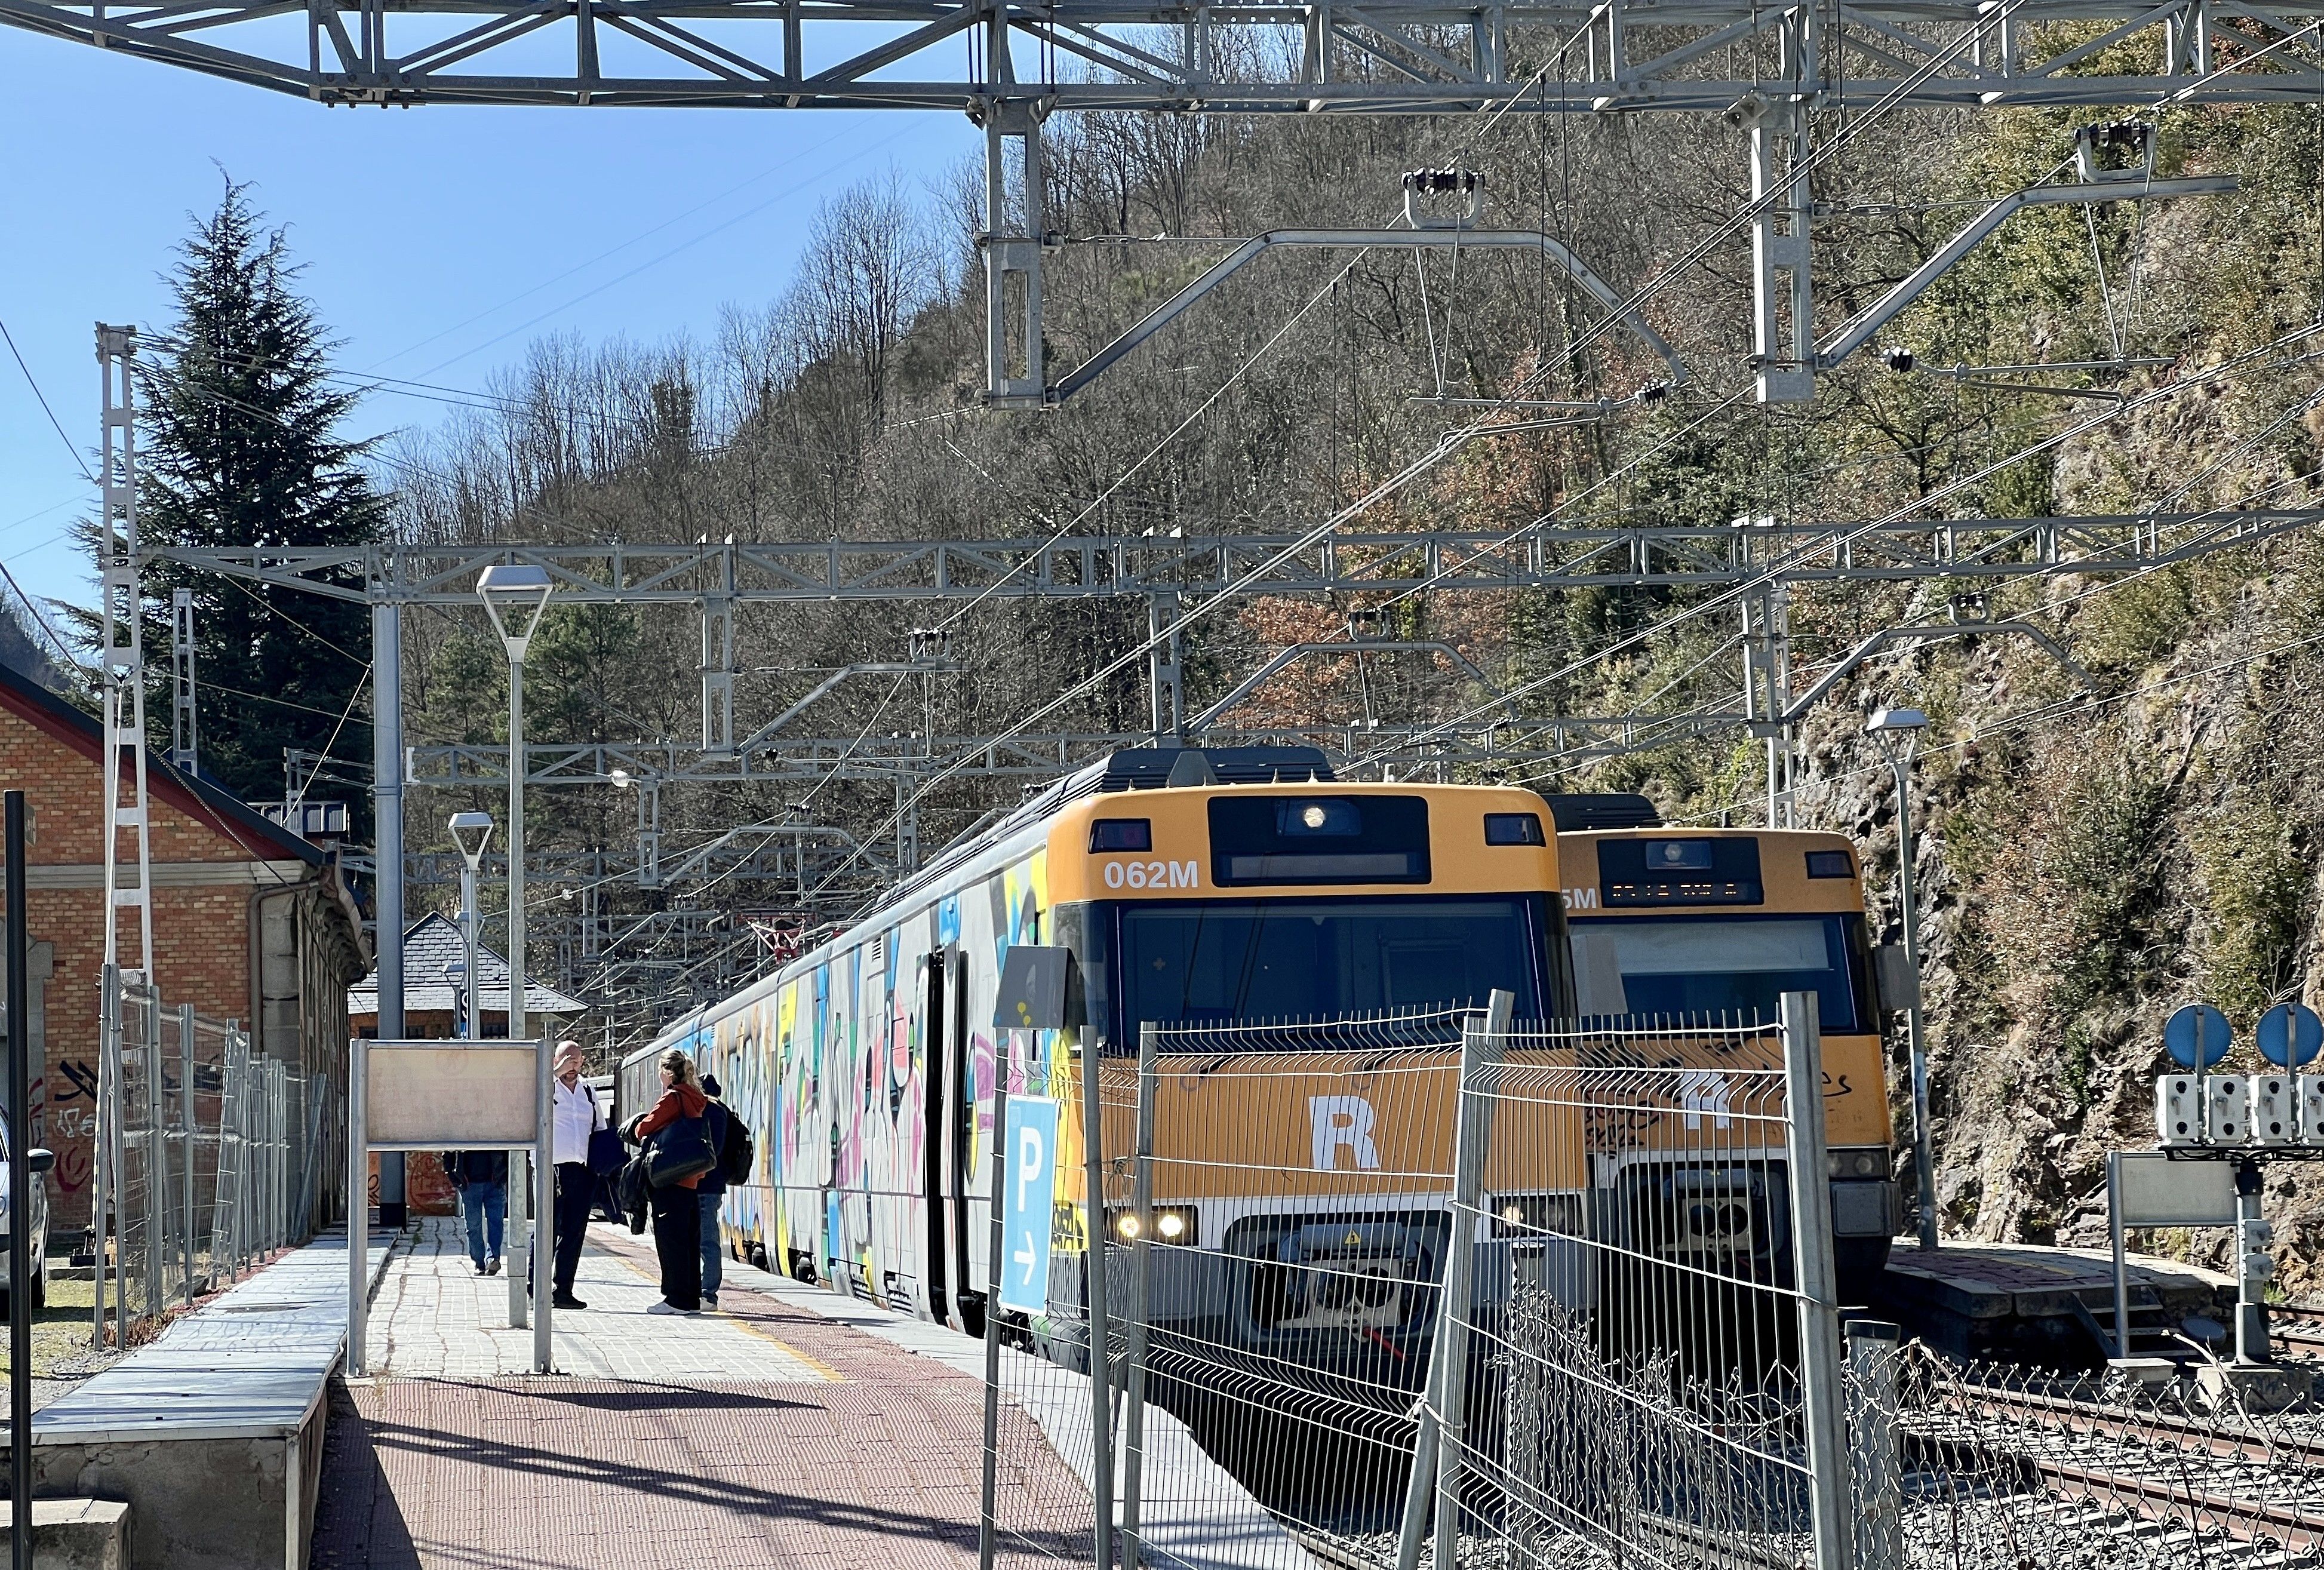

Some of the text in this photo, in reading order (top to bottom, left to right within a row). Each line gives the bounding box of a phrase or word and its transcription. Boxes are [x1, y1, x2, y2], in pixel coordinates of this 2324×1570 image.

[1104, 861, 1198, 889] 062M
[1308, 1095, 1380, 1170] R
[1679, 1071, 1734, 1130] R
[1017, 1127, 1043, 1212] P
